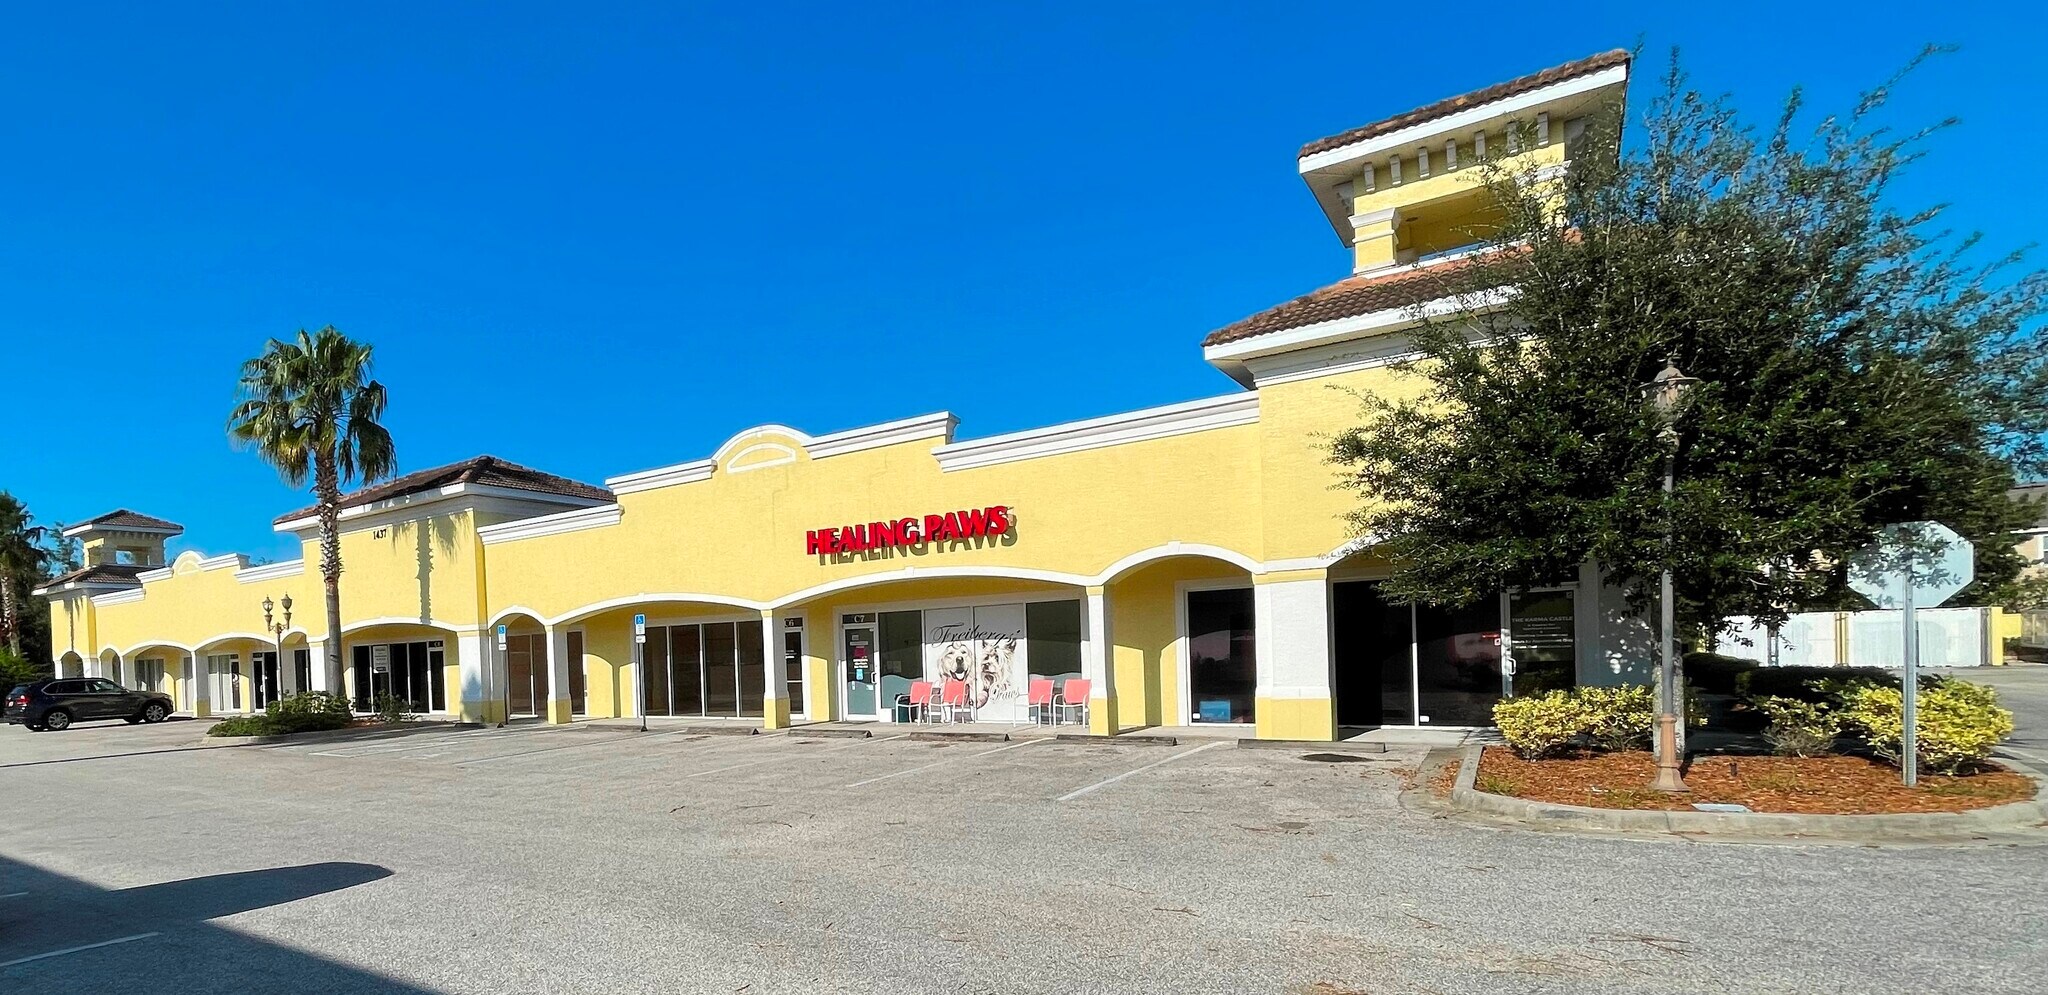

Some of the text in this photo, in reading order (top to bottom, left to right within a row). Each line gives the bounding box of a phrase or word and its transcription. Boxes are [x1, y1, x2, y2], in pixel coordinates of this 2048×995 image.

[372, 528, 387, 540] 1437
[806, 505, 1009, 555] HEALING PAWS
[854, 615, 865, 623] C7
